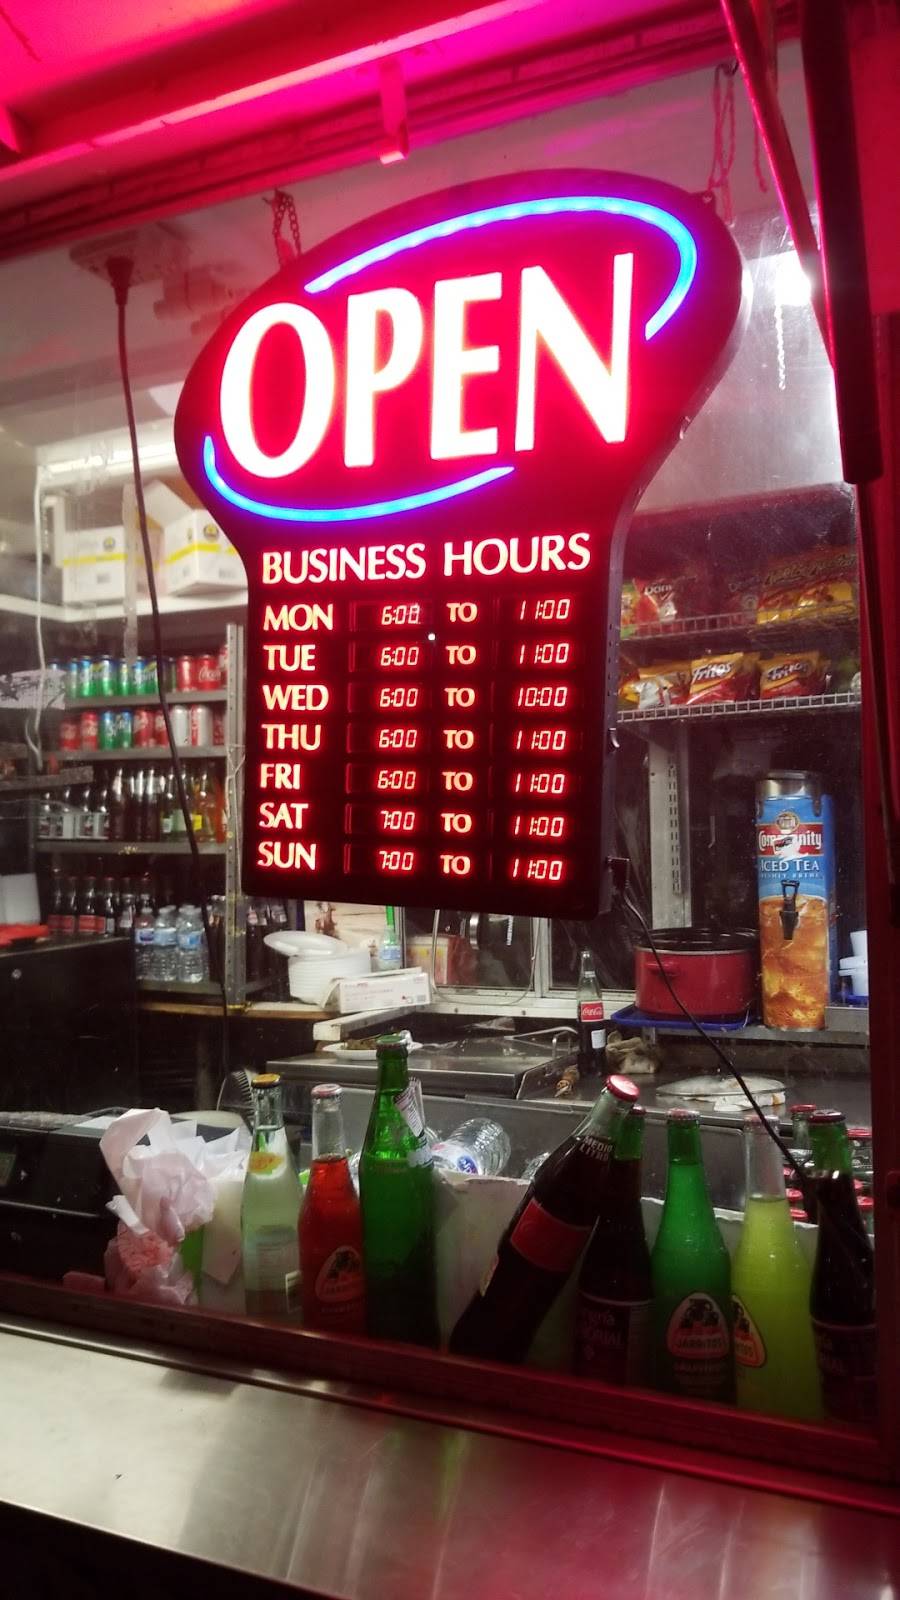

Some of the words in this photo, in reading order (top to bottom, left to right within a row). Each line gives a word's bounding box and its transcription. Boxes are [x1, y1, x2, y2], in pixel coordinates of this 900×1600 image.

[219, 252, 634, 479] OPEN
[261, 542, 426, 585] BUSINESS
[443, 532, 591, 577] HOURS
[262, 603, 334, 632] MON
[446, 602, 478, 623] TO
[519, 598, 571, 621] 11:00
[262, 644, 316, 672] TUE
[380, 646, 420, 666] 6:00
[445, 644, 477, 665] TO
[519, 642, 570, 664] 11:00
[690, 662, 734, 686] Fritos
[262, 684, 329, 711] WED
[379, 687, 418, 708] 6:00
[444, 686, 476, 708] TO
[517, 685, 568, 708] 10:00
[261, 723, 322, 751] THU
[378, 729, 418, 749] 6:00
[443, 729, 475, 750] TO
[515, 730, 567, 751] 11:00
[259, 763, 301, 790] FRI
[377, 770, 417, 791] 6:00
[441, 770, 474, 792] TO
[514, 773, 566, 795] 11:00
[258, 801, 309, 830] SAT
[380, 810, 416, 831] 7:00
[440, 812, 473, 834] TO
[513, 816, 565, 838] 11:00
[257, 841, 317, 871] SUN
[378, 850, 415, 872] 7:00
[439, 854, 472, 876] TO
[512, 858, 563, 881] 11:00
[760, 859, 790, 872] ICED
[793, 859, 820, 871] TEA
[583, 1135, 614, 1153] MEDIO
